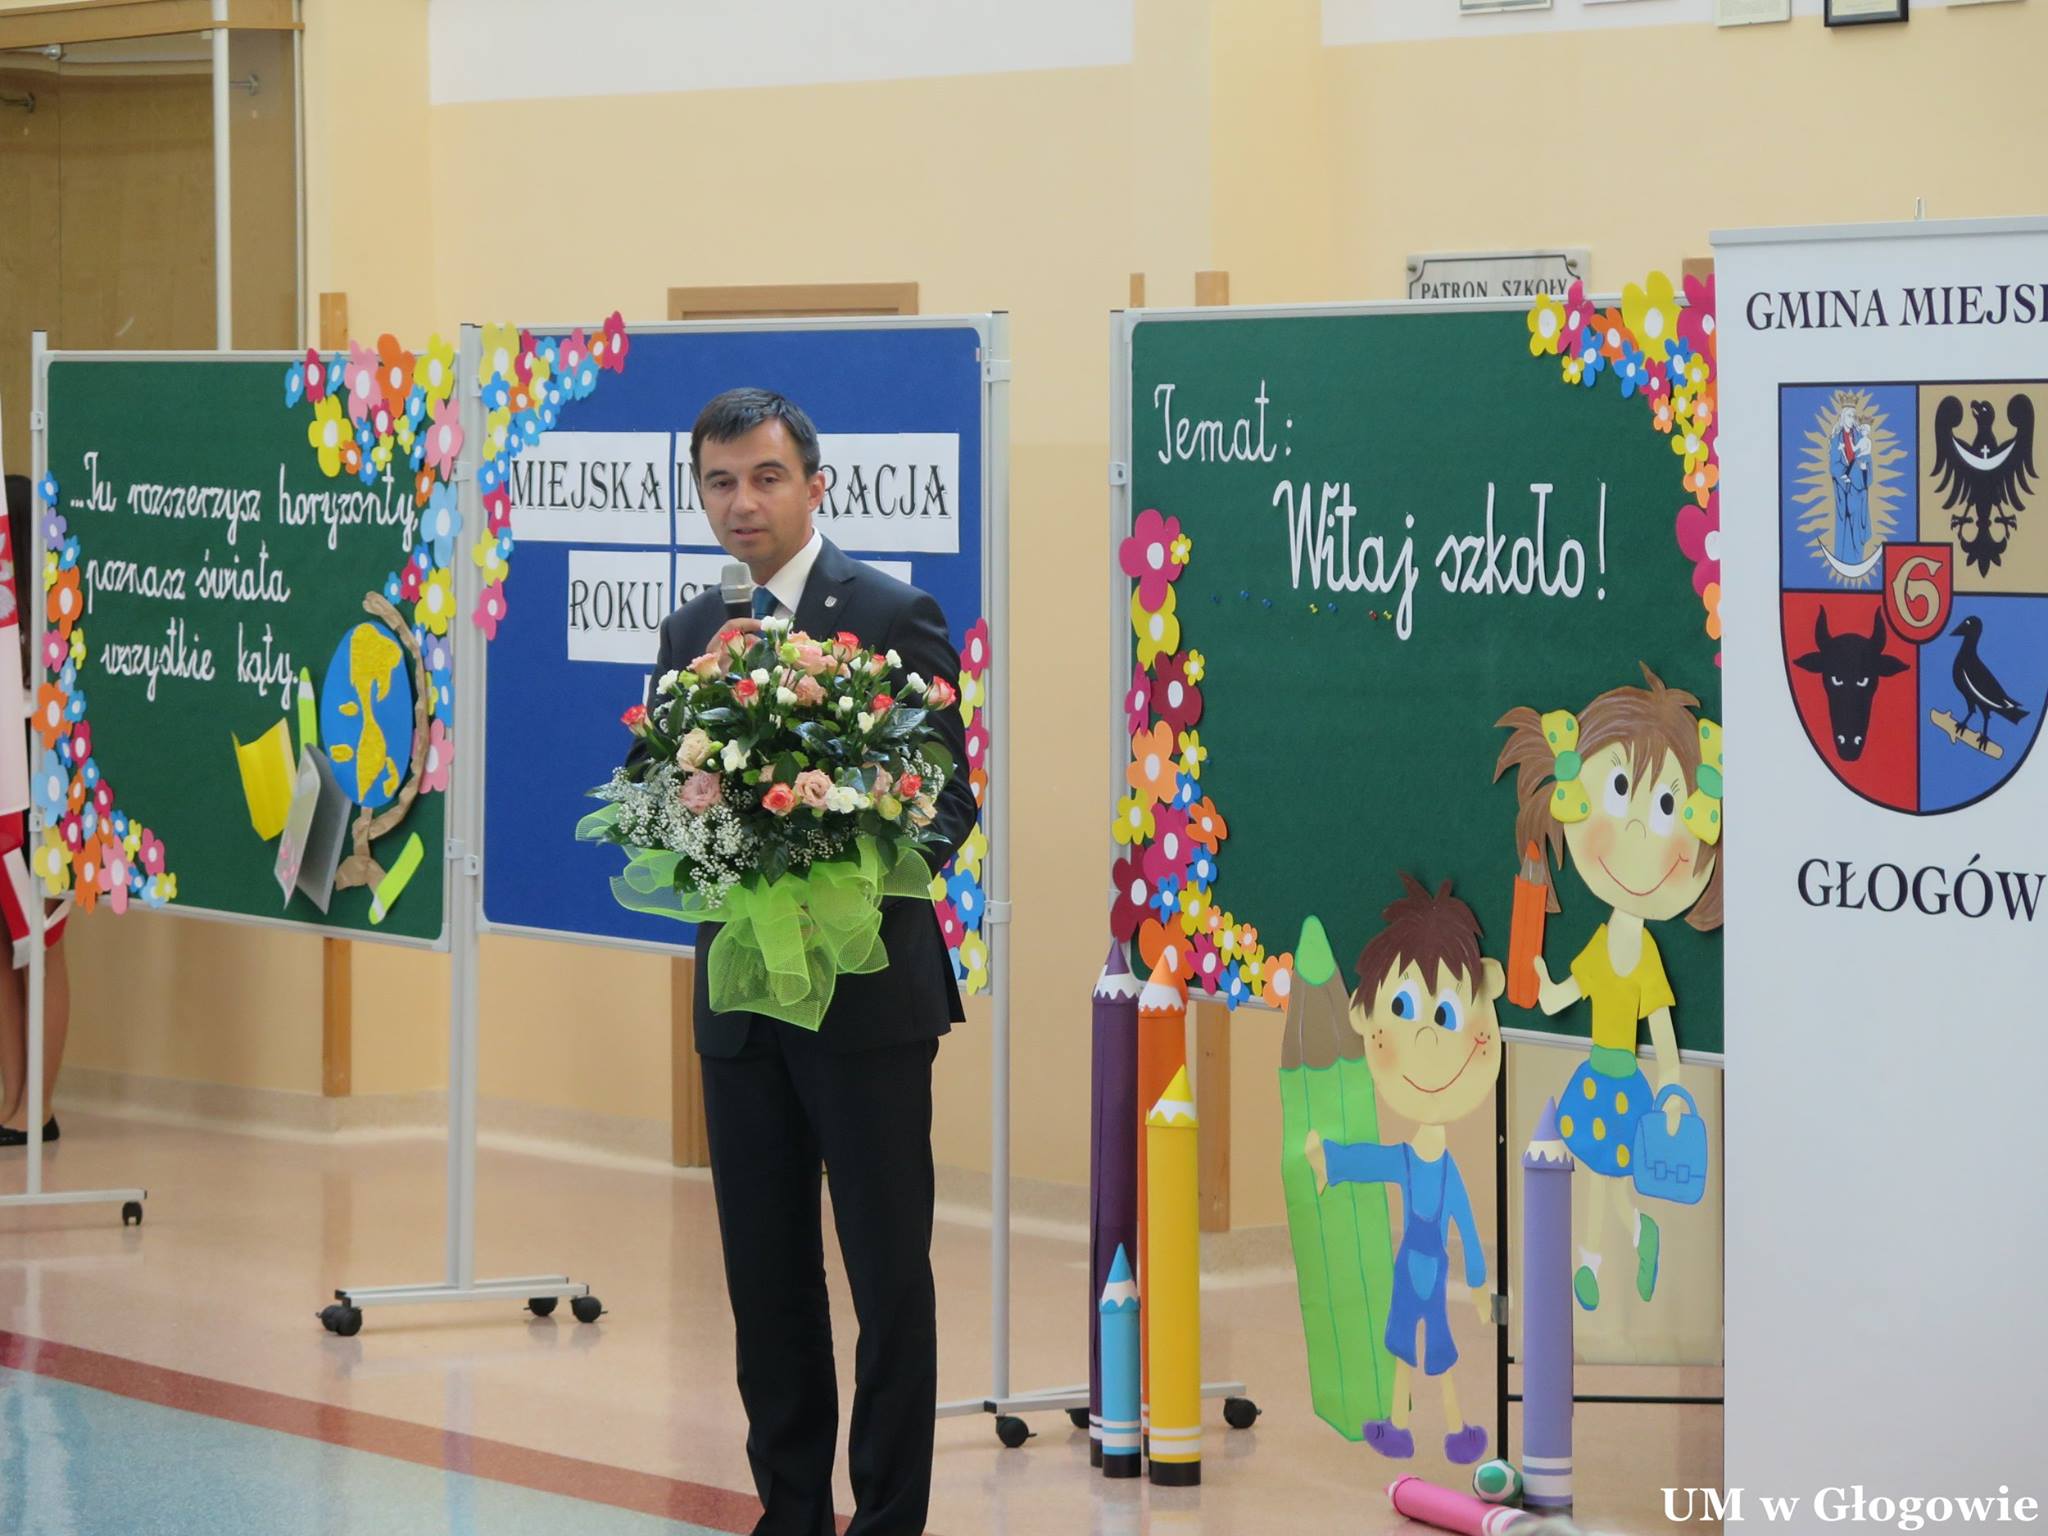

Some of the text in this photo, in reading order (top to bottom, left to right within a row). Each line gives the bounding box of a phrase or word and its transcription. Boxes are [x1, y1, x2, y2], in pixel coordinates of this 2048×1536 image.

[1421, 278, 1568, 300] PATRON SZKOŁY
[1745, 283, 2048, 330] GMINA MIEJS
[127, 483, 262, 546] rozszerzysz
[279, 462, 419, 552] horyzonty,
[511, 460, 665, 512] MIEJSKA
[86, 539, 291, 615] poznasz świata
[1272, 479, 1419, 641] Witaj
[569, 578, 664, 632] ROKU
[100, 616, 299, 711] wszystkie kąty.
[1797, 852, 2048, 922] GŁOGÓW
